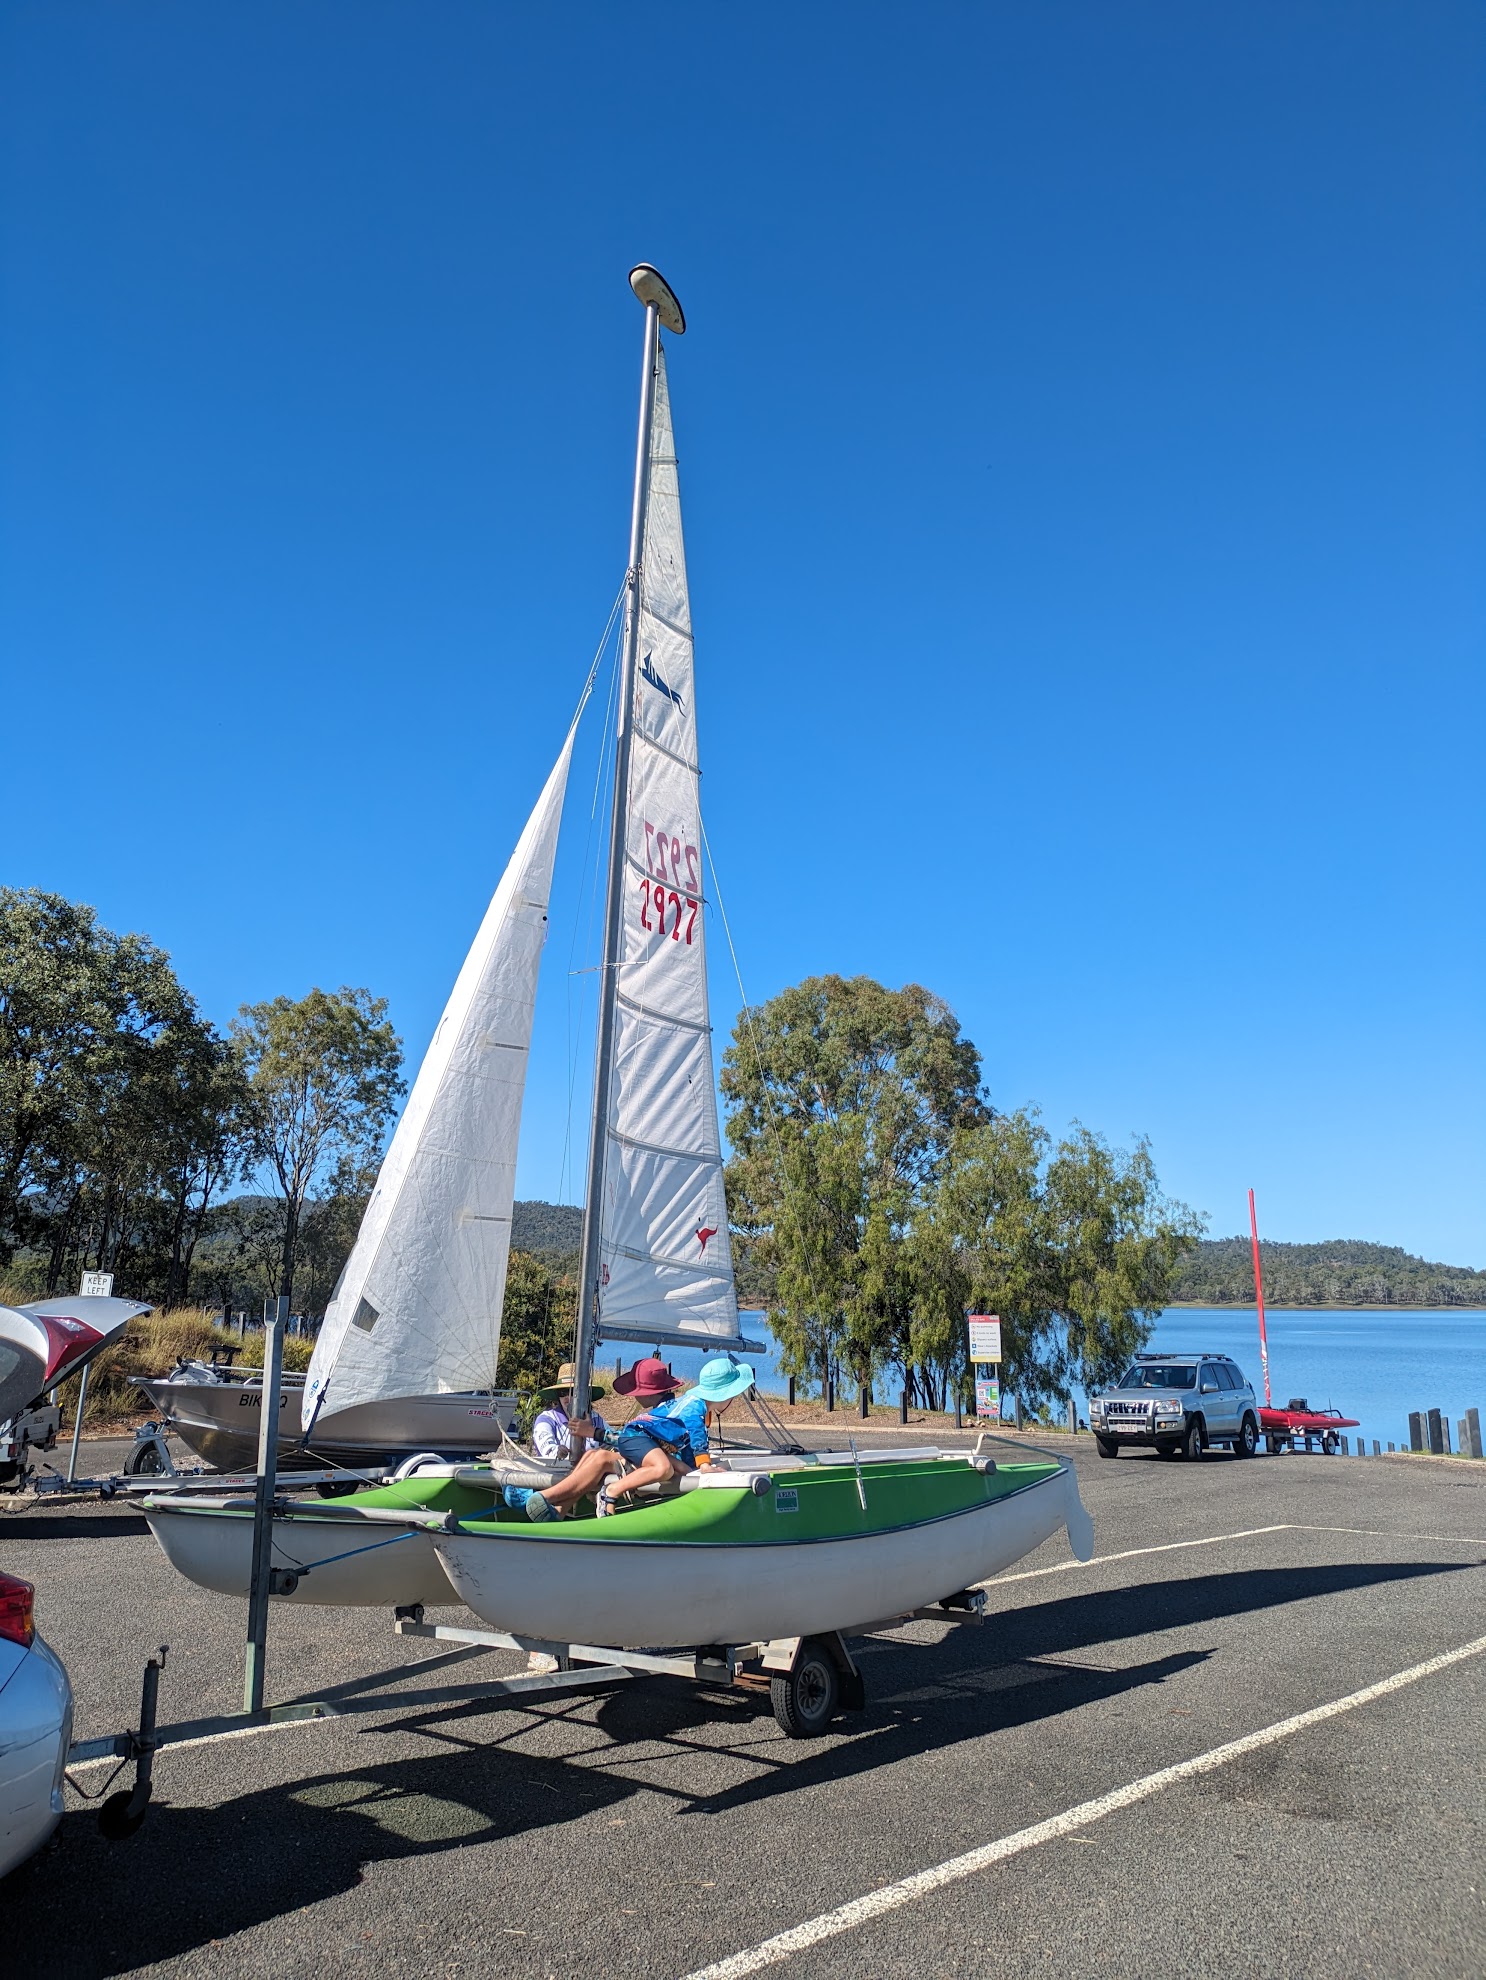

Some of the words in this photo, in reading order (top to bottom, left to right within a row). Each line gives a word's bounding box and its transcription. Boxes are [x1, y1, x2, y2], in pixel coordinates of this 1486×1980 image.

[639, 879, 698, 945] 2927
[87, 1276, 108, 1286] KEEP
[87, 1286, 106, 1296] LEFT
